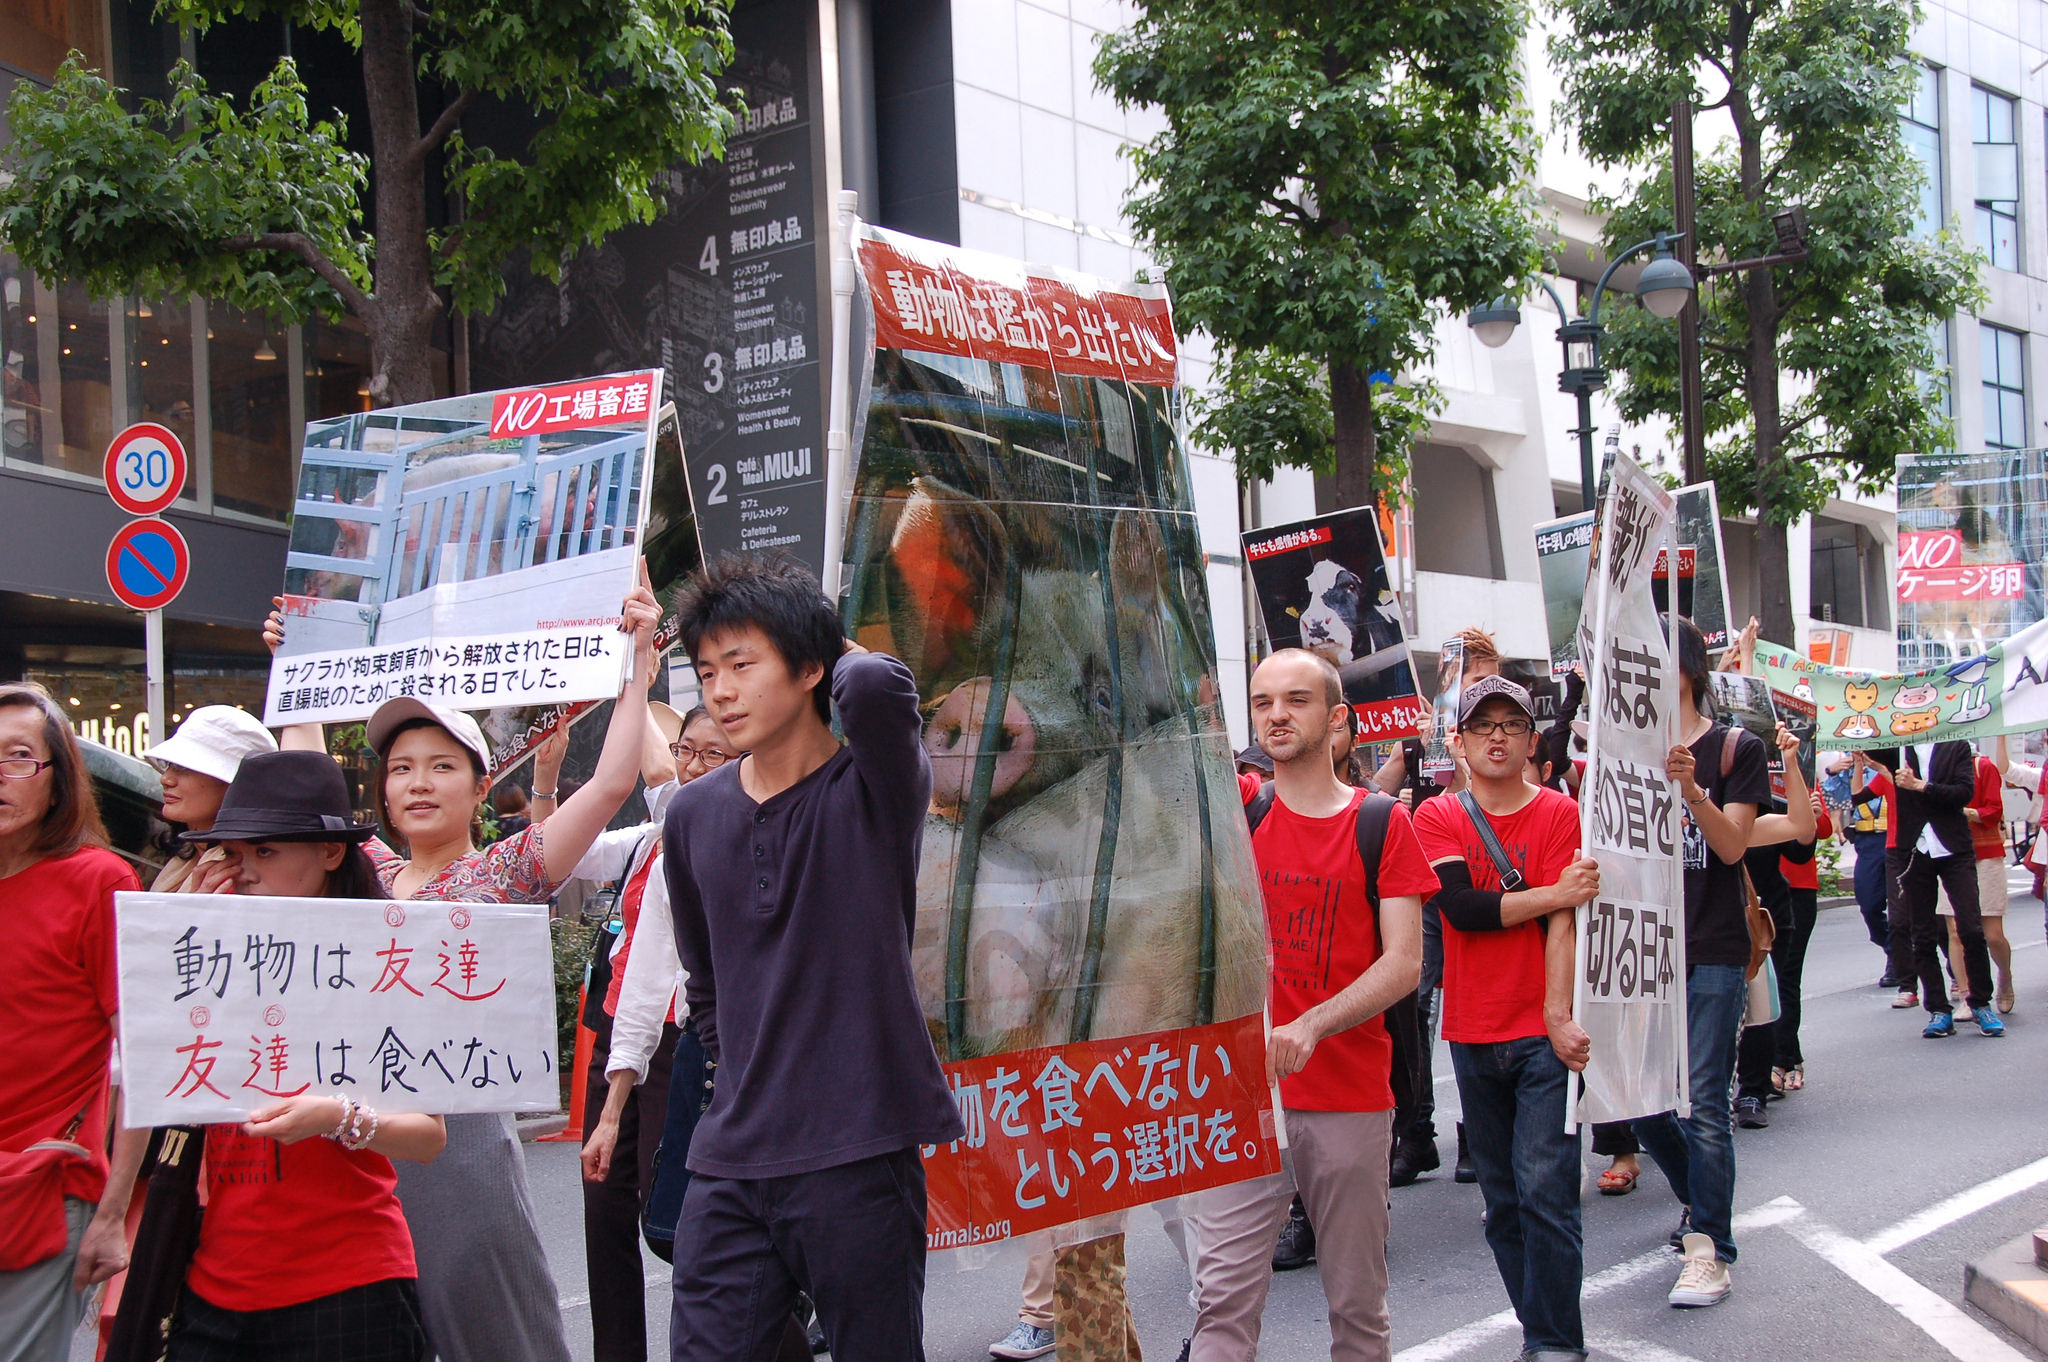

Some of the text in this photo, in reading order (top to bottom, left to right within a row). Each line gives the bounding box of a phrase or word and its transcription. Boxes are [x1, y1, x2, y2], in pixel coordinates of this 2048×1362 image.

[729, 181, 787, 203] Childrenswear
[730, 199, 767, 216] Maternity
[730, 216, 802, 255] 無印良品
[699, 235, 720, 276] 4
[734, 304, 774, 320] Menswear
[735, 316, 775, 332] Stationery
[886, 270, 1175, 367] 動物は檻から出たい
[735, 335, 806, 371] 無印良品
[703, 352, 724, 393] 3
[493, 382, 649, 434] NO 工場畜産
[737, 405, 790, 422] Womenswear
[738, 416, 801, 435] Health & Beauty
[124, 450, 167, 490] 30
[764, 447, 811, 482] MUJI
[707, 464, 728, 506] 2
[740, 499, 759, 510] カフェ
[741, 524, 777, 538] Cafeteria
[741, 534, 801, 551] & Delicatessen
[1898, 534, 1957, 569] NO
[1897, 567, 2021, 598] ケージ卵
[536, 615, 621, 630] http://www.arcj.org
[284, 634, 612, 685] サクラが拘束飼育から解放された日は、
[173, 925, 507, 1002] 動物は友達
[1586, 898, 1675, 1000] 切る日本
[165, 1026, 552, 1101] 友達は食べない
[919, 1043, 1232, 1158] 物を食べない
[1015, 1108, 1257, 1210] という選択を。
